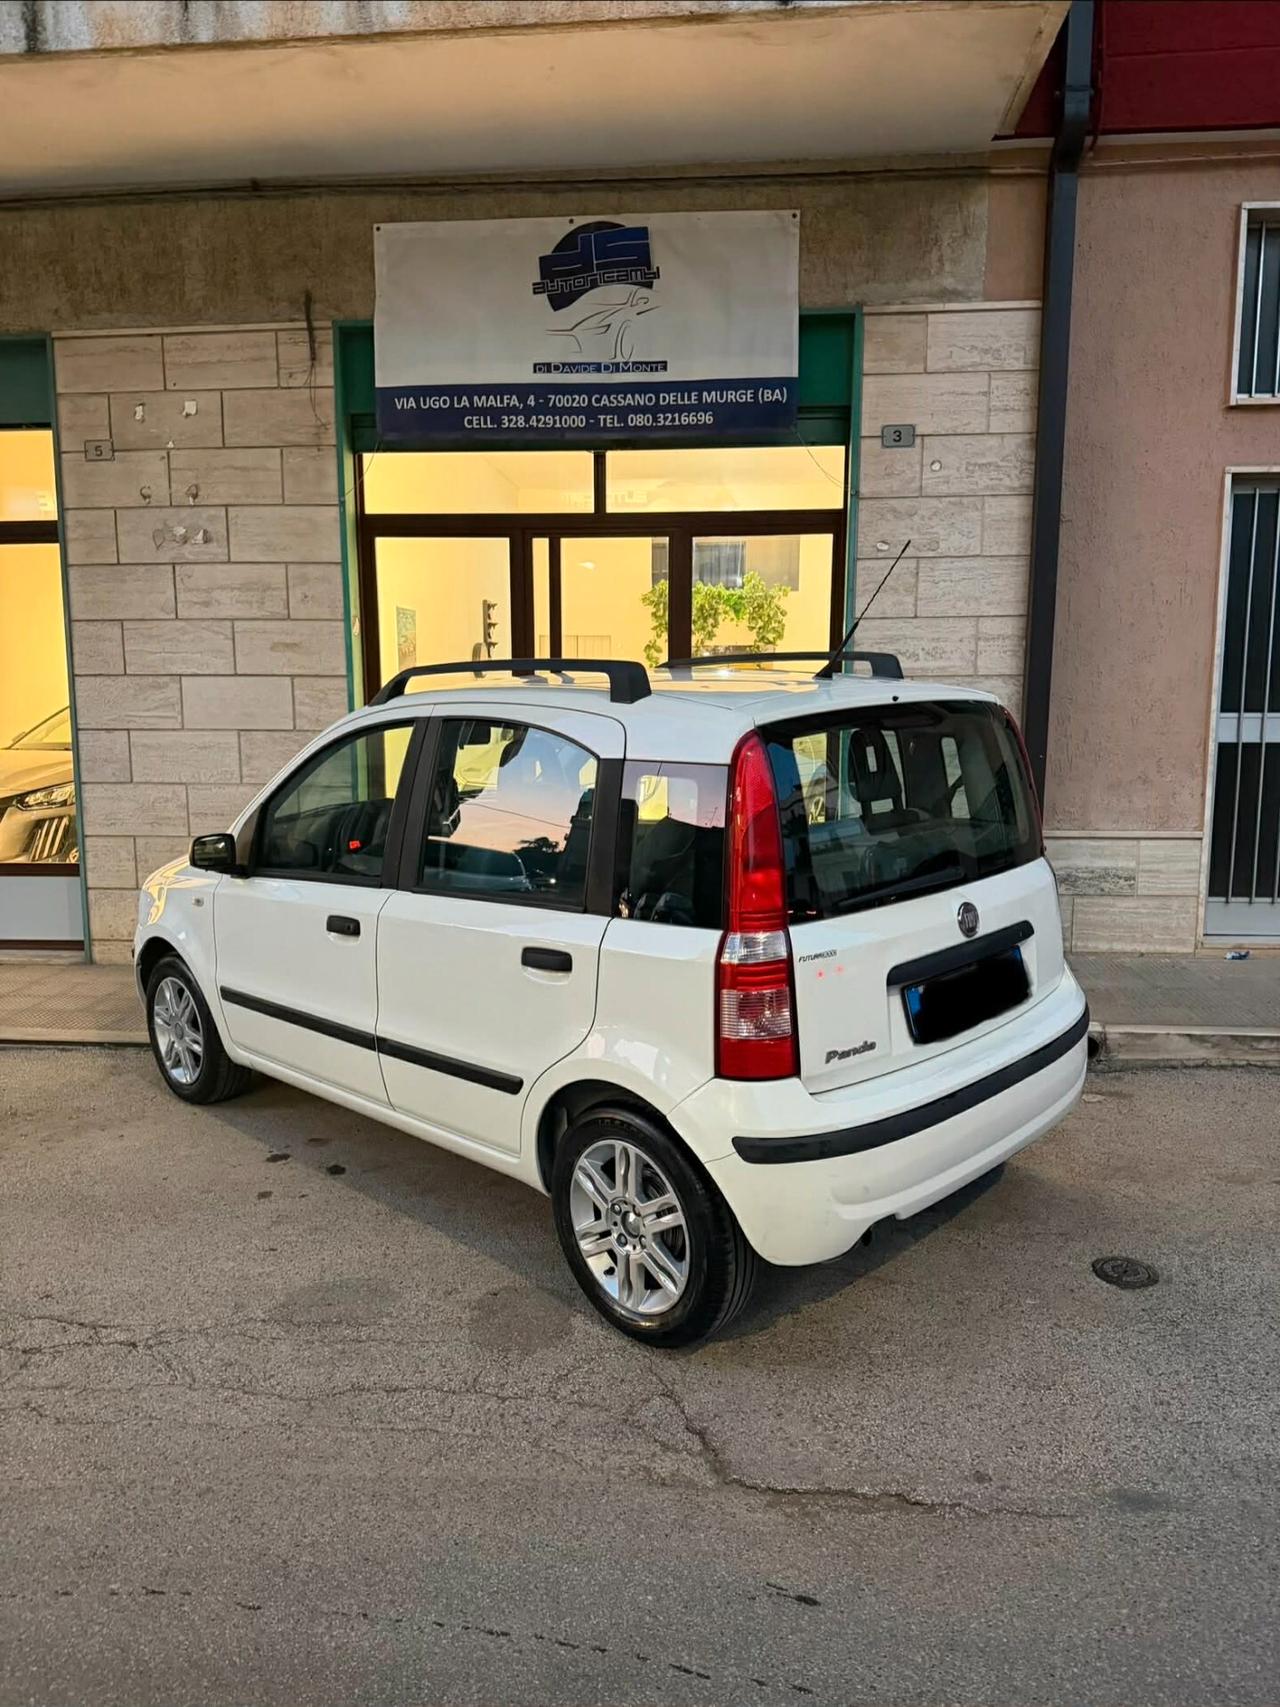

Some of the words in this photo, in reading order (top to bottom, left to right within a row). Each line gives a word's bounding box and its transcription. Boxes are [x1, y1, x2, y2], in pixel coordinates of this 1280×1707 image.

[551, 362, 597, 374] DAVIDE
[601, 362, 616, 373] DI
[620, 361, 666, 373] MONTE
[394, 397, 417, 410] VIA
[420, 396, 450, 409] UGO
[453, 396, 470, 408] LA
[473, 395, 523, 410] MALFA,
[526, 395, 536, 408] 4
[548, 394, 588, 408] 70020
[591, 394, 656, 408] CASSANO
[659, 391, 699, 406] DELLE
[702, 389, 755, 404] MURGE
[758, 386, 788, 404] (BA)
[463, 416, 498, 428] CELL.
[501, 414, 586, 428] 328.4291000
[598, 415, 625, 427] TEL.
[627, 411, 714, 427] 080.3216696
[892, 430, 902, 443] 3
[95, 445, 103, 457] 5
[825, 1040, 877, 1064] Panda
